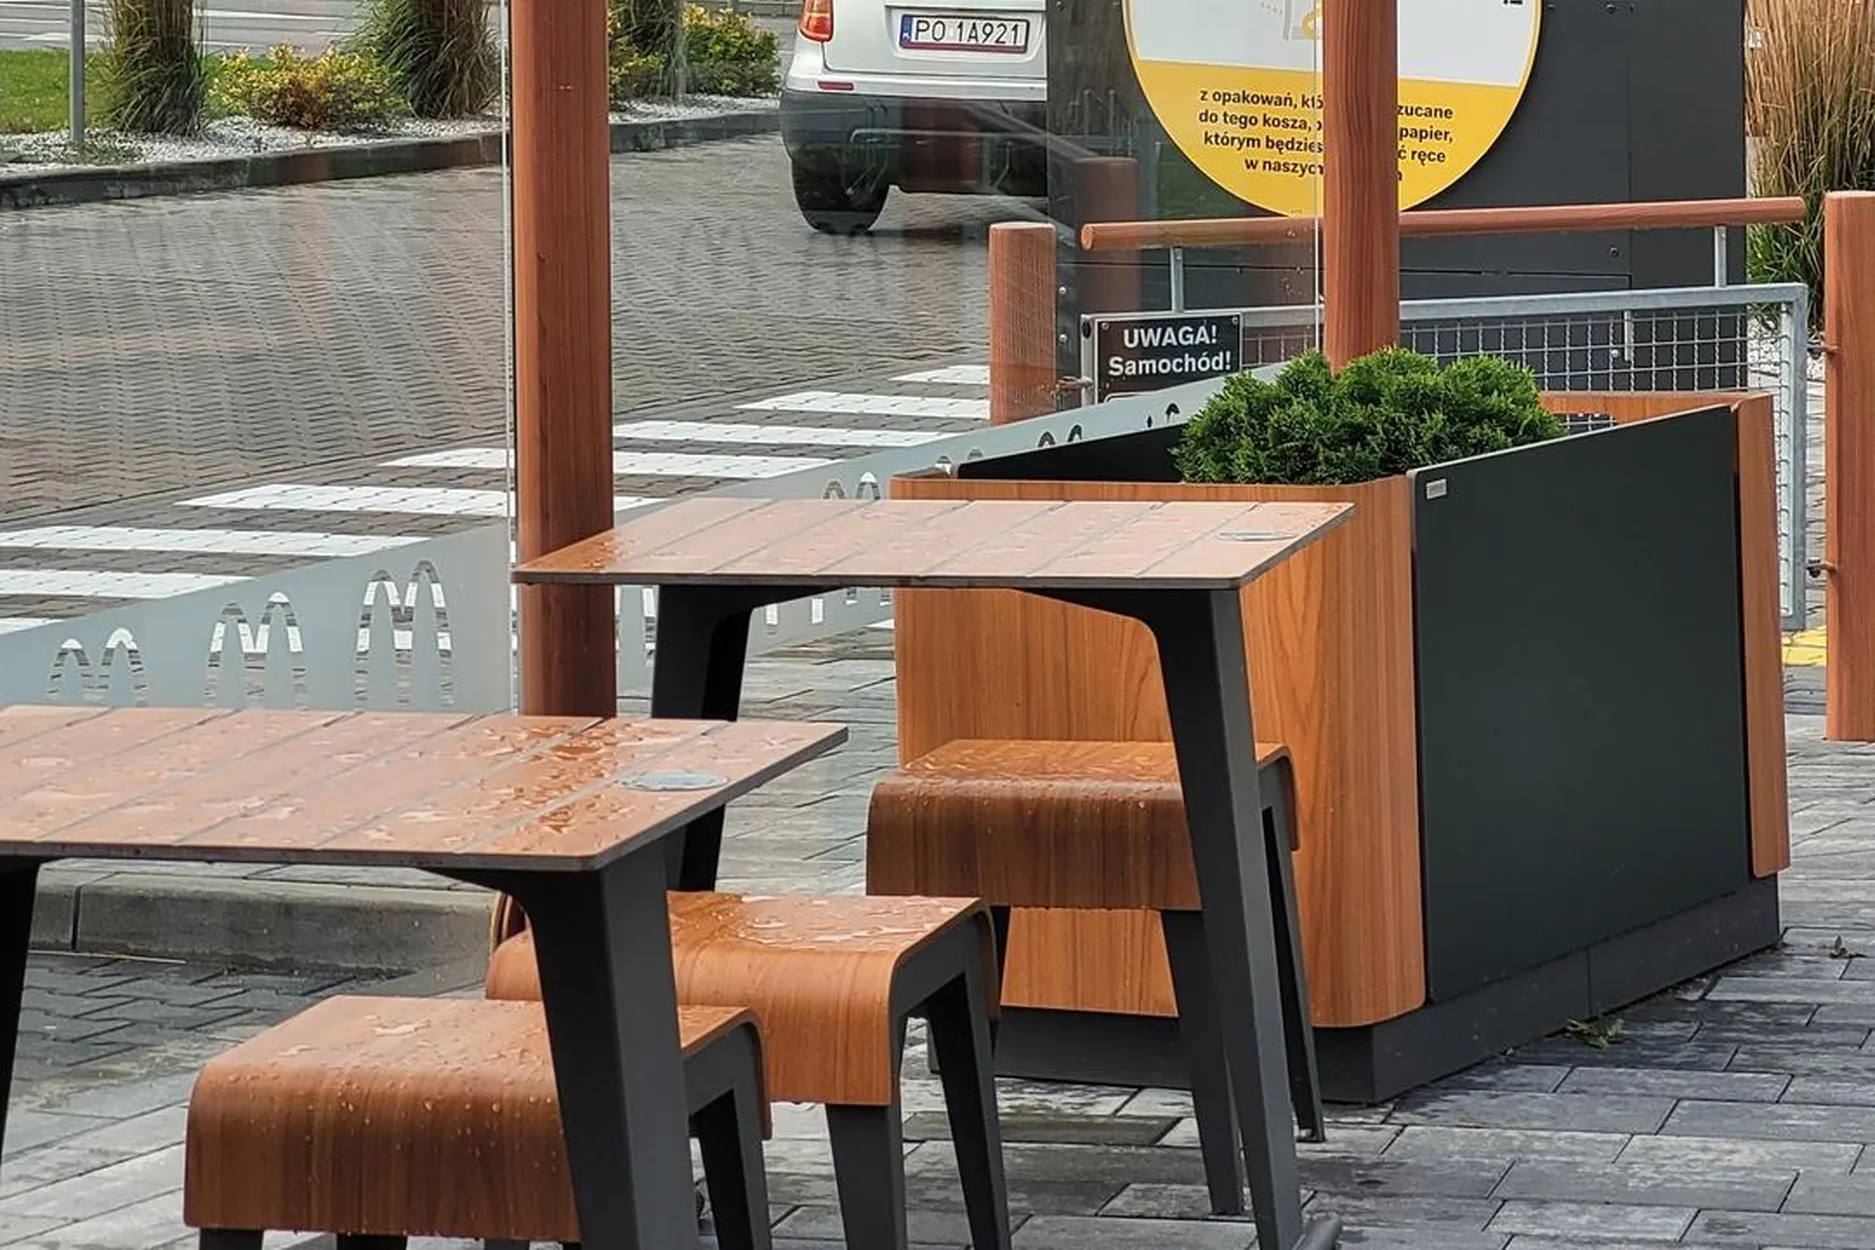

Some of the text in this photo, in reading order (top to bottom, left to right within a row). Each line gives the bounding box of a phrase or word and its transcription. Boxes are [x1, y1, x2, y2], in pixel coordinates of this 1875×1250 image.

[915, 20, 946, 41] PO
[957, 21, 1019, 45] 1A921
[1200, 90, 1453, 119] z opakowań, któ zucane
[1199, 109, 1218, 123] do
[1223, 111, 1258, 129] tego
[1263, 113, 1312, 132] kosza,
[1399, 125, 1453, 144] papier,
[1204, 131, 1261, 151] którym
[1265, 135, 1323, 155] będzies
[1411, 150, 1446, 166] ręce
[1245, 159, 1258, 170] w
[1123, 324, 1217, 348] UWAGA!
[1108, 350, 1231, 376] Samochód!
